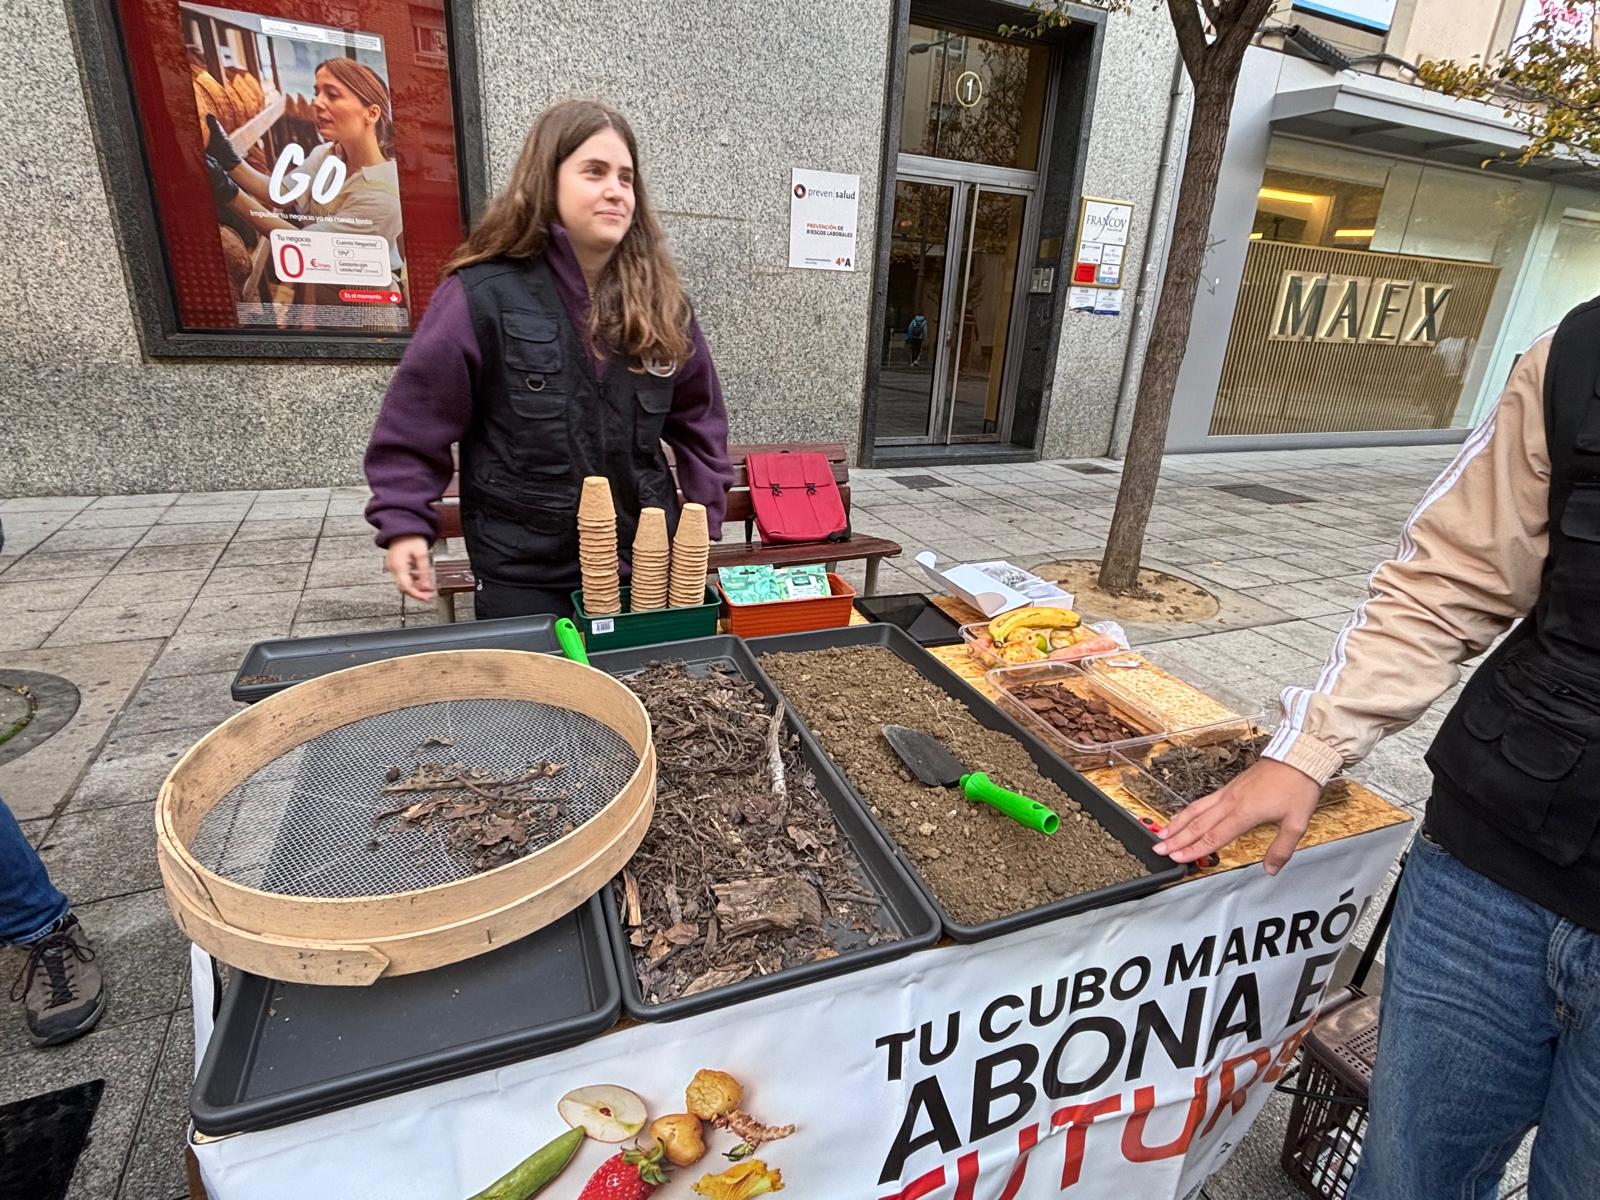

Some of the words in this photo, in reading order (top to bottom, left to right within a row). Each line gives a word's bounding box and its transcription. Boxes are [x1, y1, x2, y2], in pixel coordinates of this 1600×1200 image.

[966, 78, 974, 101] 1
[268, 143, 347, 206] GO
[808, 188, 833, 199] preven
[835, 189, 856, 200] salud
[289, 213, 315, 222] negocio
[806, 222, 837, 230] PREVENCIÓN
[277, 233, 285, 241] Tu
[286, 235, 311, 243] negocio
[279, 243, 305, 278] 0
[1273, 272, 1453, 345] MAEX
[876, 1010, 961, 1082] TU
[979, 955, 1152, 1043] CUBO
[877, 972, 1263, 1185] ABONA
[1285, 948, 1341, 1028] E
